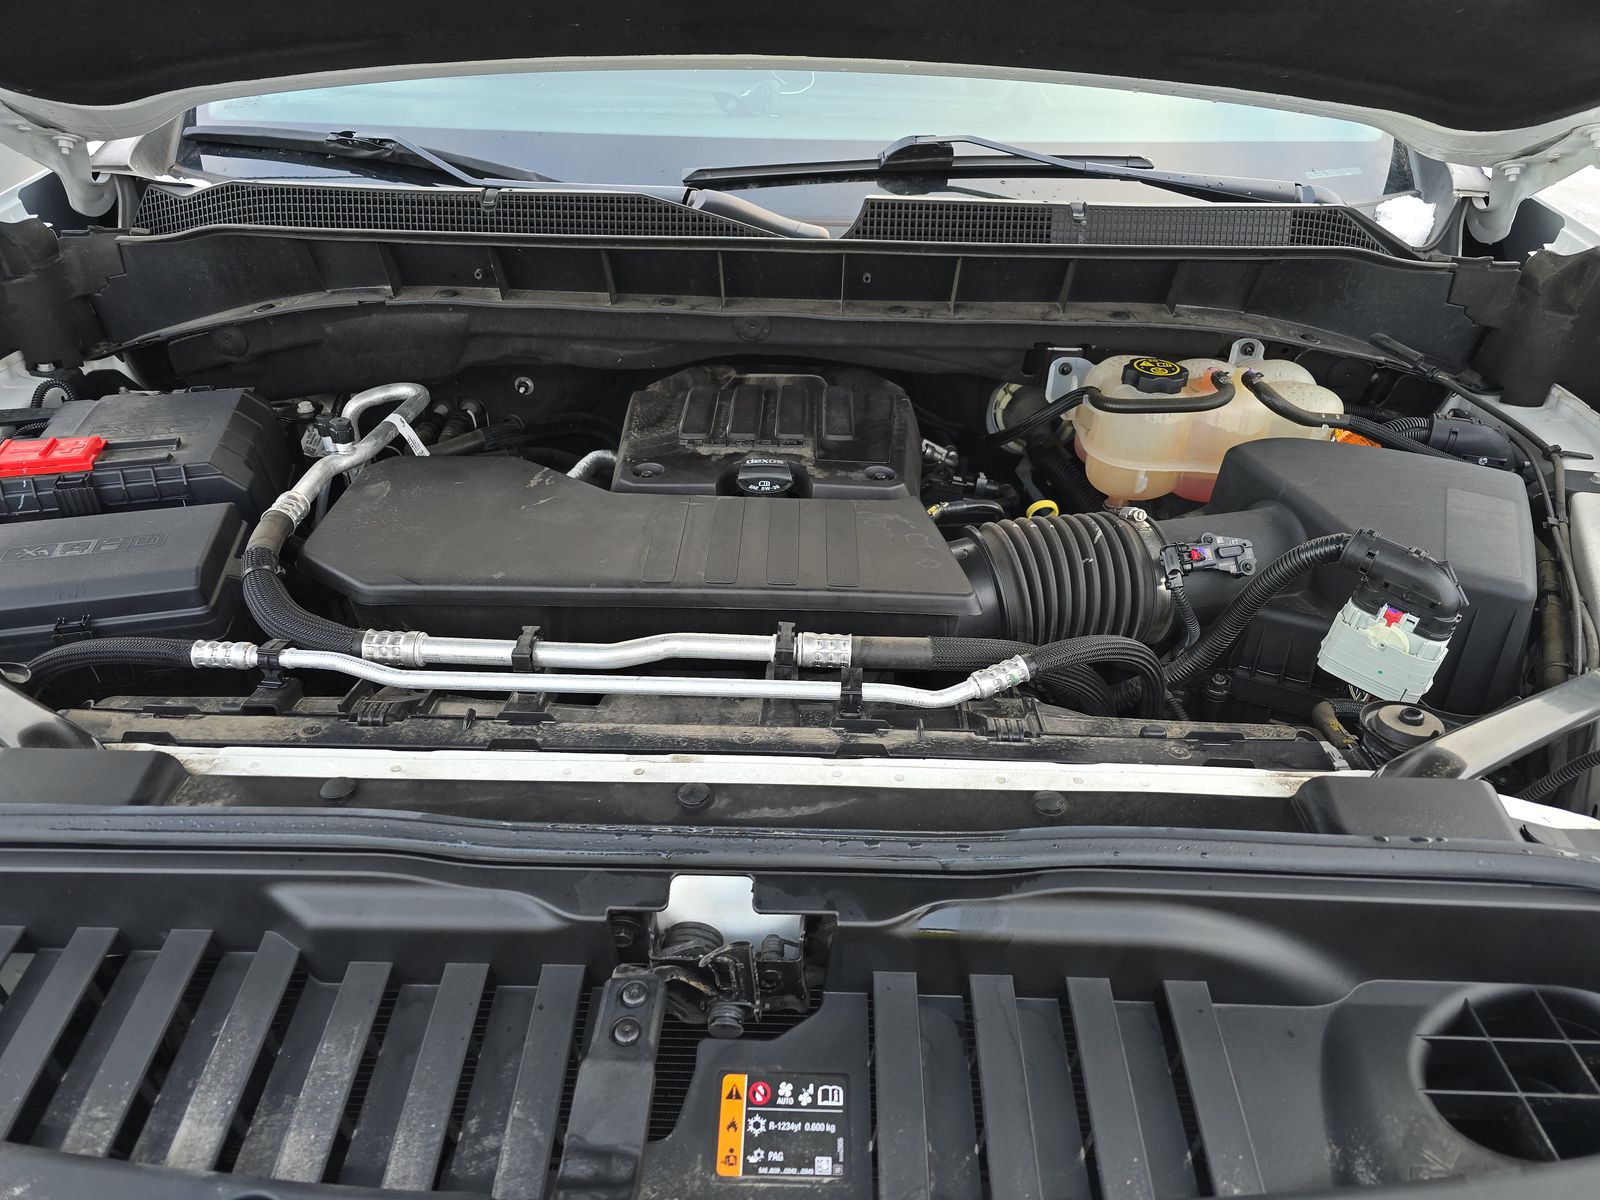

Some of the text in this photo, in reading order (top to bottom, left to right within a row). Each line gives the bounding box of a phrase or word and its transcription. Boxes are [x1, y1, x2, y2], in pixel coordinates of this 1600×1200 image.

[776, 1096, 795, 1105] AUTO
[825, 1123, 836, 1134] kg
[767, 1151, 785, 1162] PAG
